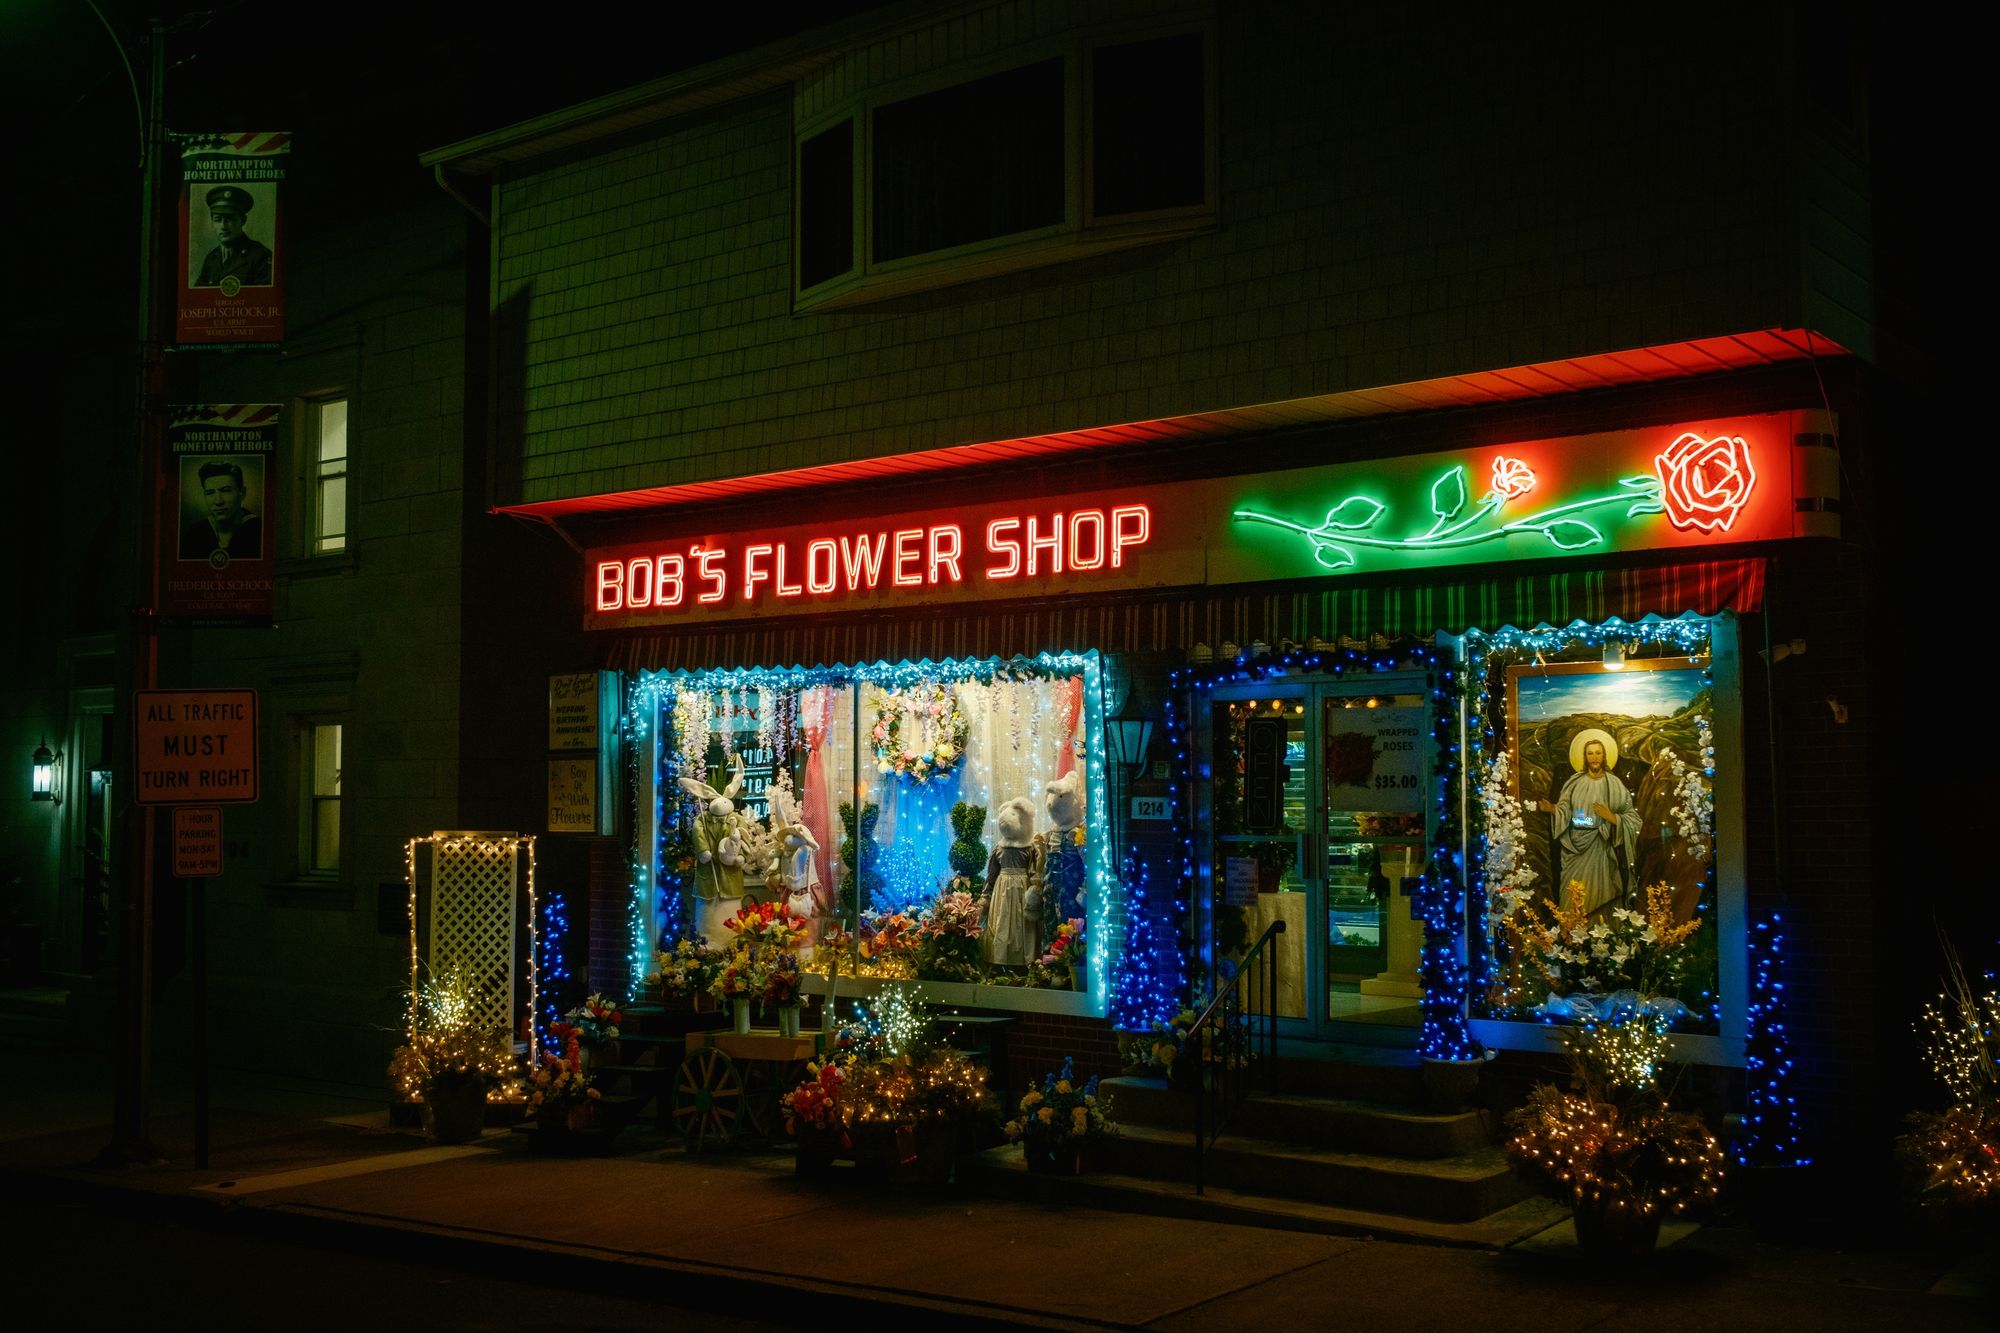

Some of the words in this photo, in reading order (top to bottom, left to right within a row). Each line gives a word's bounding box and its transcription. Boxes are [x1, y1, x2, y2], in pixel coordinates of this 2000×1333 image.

[195, 159, 274, 171] NORTHAMPTON
[184, 169, 242, 181] HOMETOWN
[245, 168, 286, 180] HEROES
[179, 306, 217, 321] JOSEPH
[218, 306, 266, 318] SCHOCK,
[267, 306, 281, 318] JR.
[184, 431, 262, 442] NORTHAMPTON
[172, 441, 233, 452] HOMETOWN
[234, 440, 273, 451] HEROES
[596, 543, 727, 611] BOB'S
[744, 524, 964, 599] FLOWER
[985, 503, 1151, 580] SHOP
[168, 579, 225, 591] FREDERICK
[226, 579, 273, 591] SCHOCK
[147, 704, 175, 722] ALL
[184, 703, 244, 721] TRAFFIC
[556, 705, 586, 714] WEDDING
[1377, 728, 1419, 737] WRAPPED
[163, 735, 228, 757] MUST
[1383, 741, 1414, 751] ROSES
[142, 771, 189, 788] TURN
[200, 769, 250, 786] RIGHT
[570, 764, 587, 783] Say
[1253, 724, 1275, 825] OPEN
[1375, 774, 1417, 790] $35.00
[568, 792, 590, 806] With
[1138, 801, 1164, 816] 1214
[190, 814, 214, 824] HOUR
[551, 807, 592, 825] Flowers
[179, 828, 216, 839] PARKING
